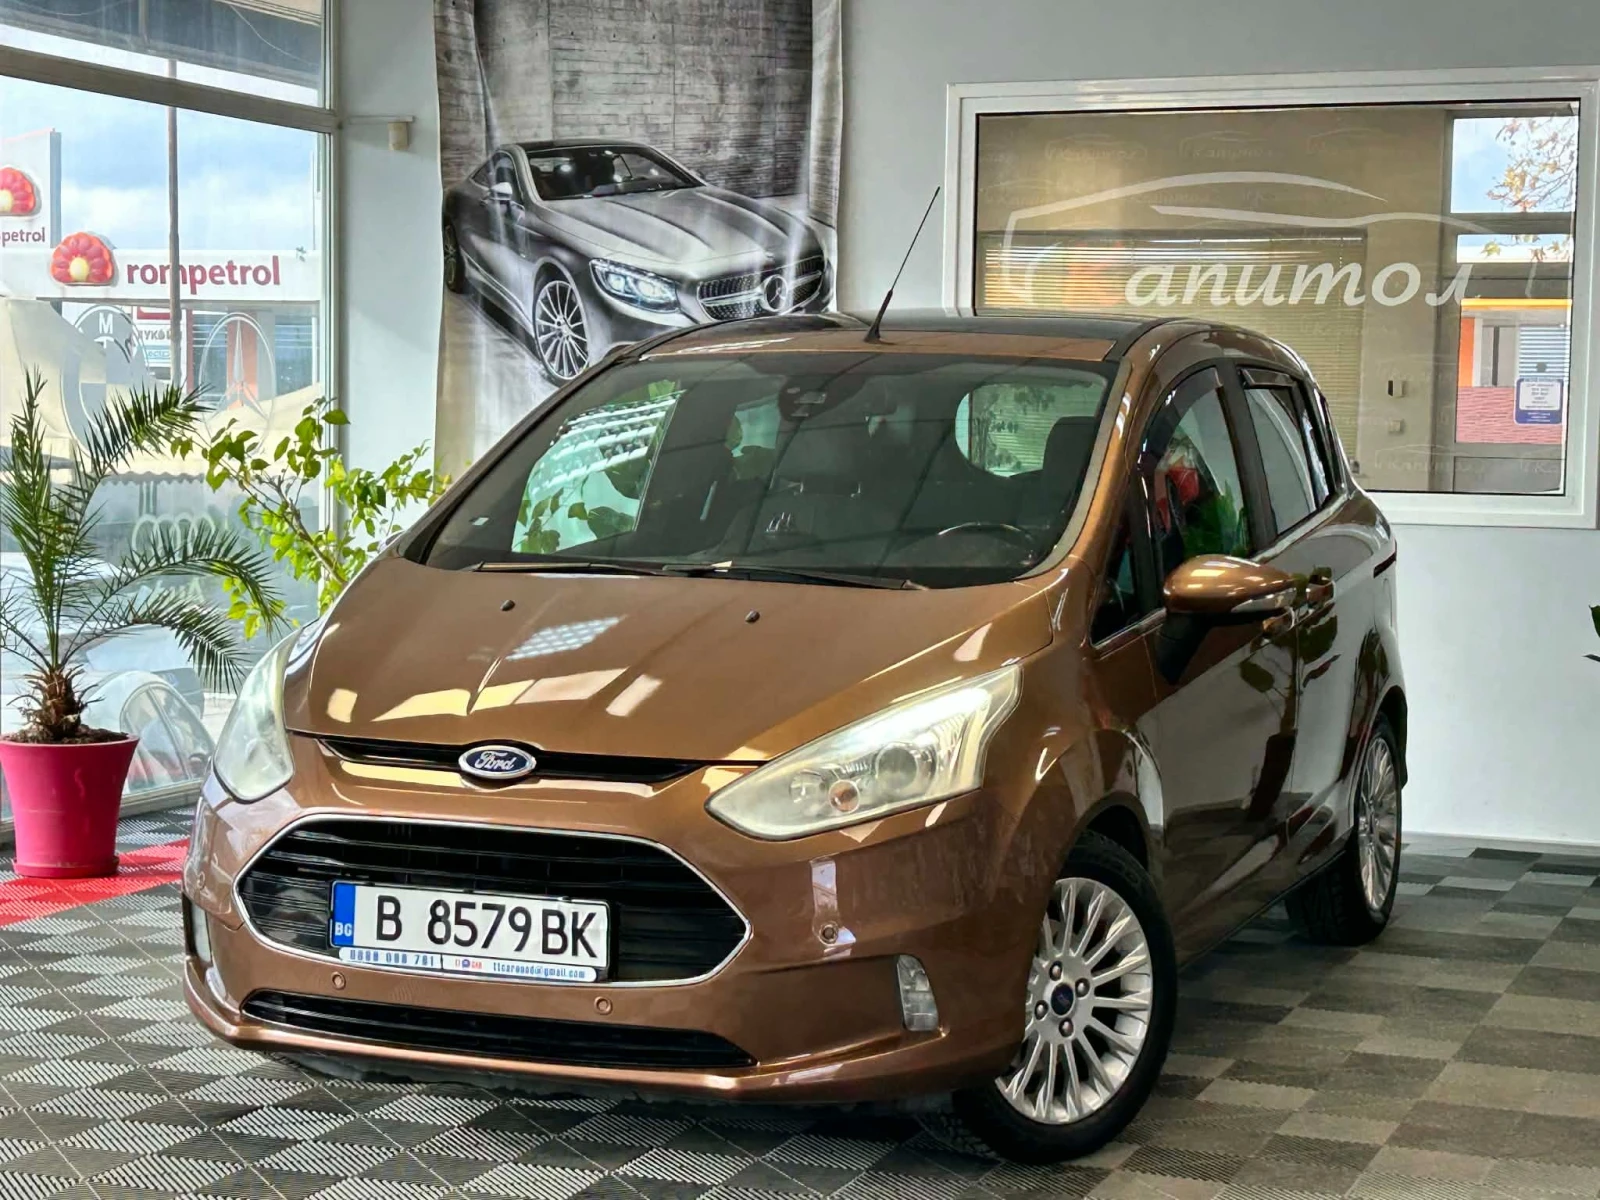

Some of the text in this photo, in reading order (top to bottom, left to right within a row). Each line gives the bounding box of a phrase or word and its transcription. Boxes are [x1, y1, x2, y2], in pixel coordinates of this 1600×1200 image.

[0, 226, 46, 248] petrol
[127, 255, 281, 295] rompetrol
[474, 750, 518, 770] Ford
[334, 922, 353, 937] BG
[376, 895, 598, 959] B 8579 BK
